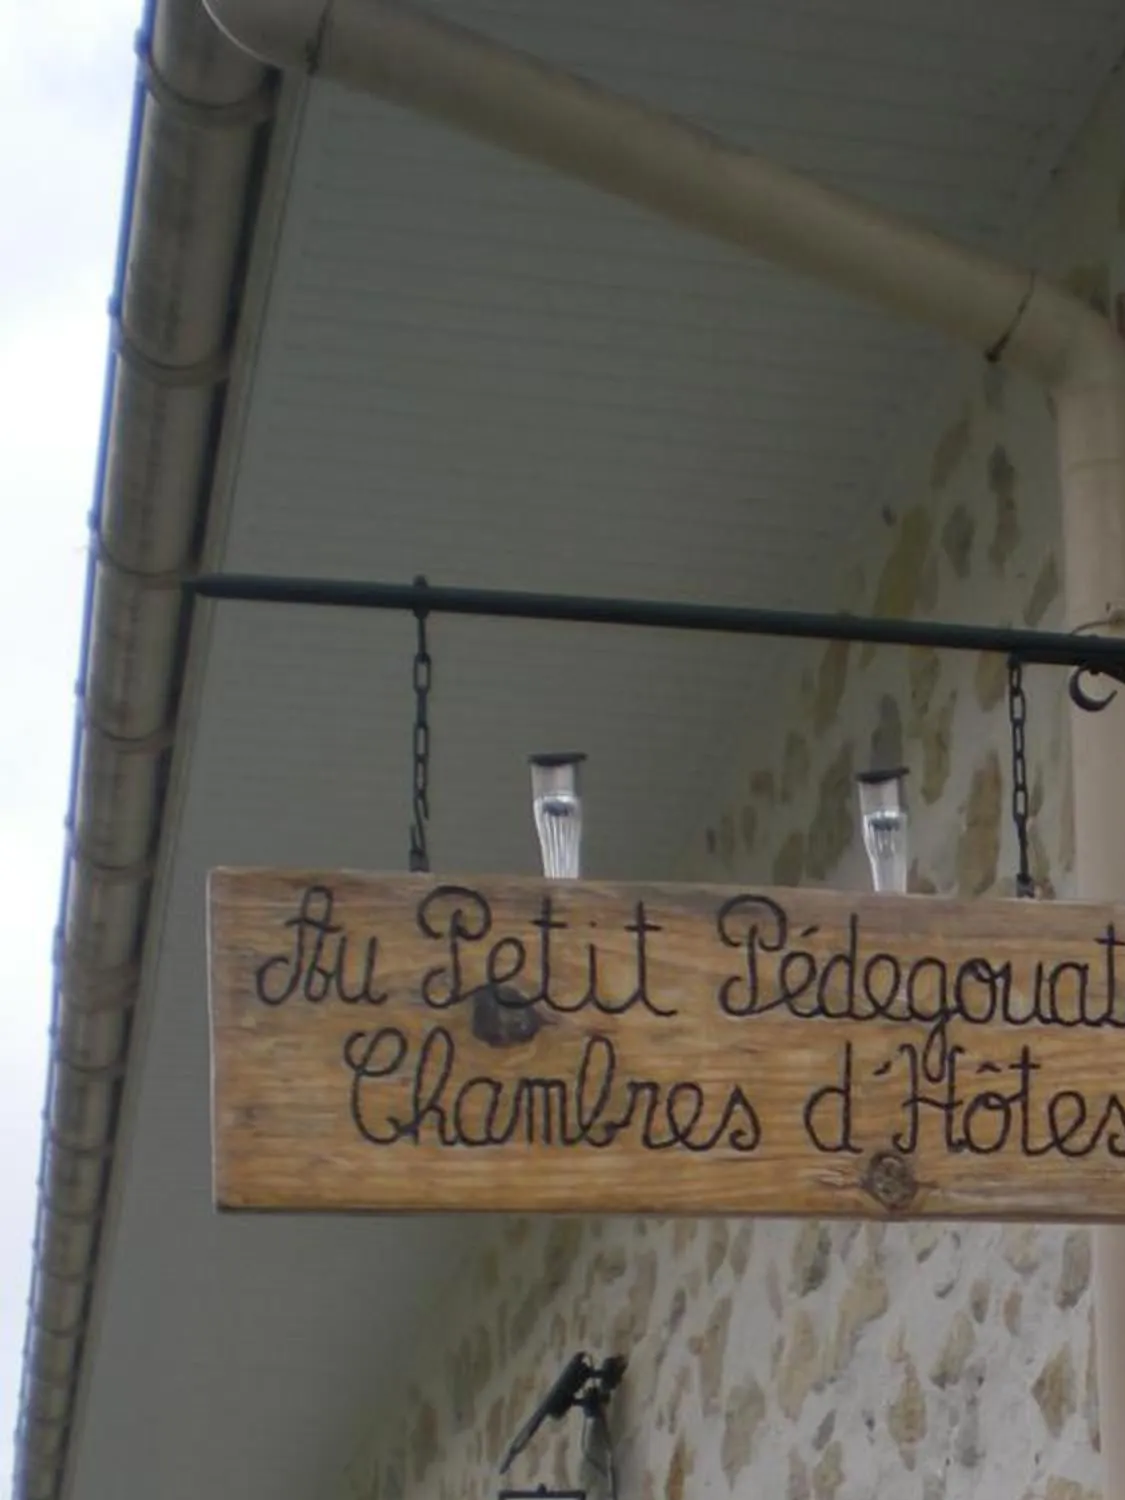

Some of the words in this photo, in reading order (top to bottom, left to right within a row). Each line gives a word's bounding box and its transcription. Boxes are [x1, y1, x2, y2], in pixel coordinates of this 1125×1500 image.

[255, 885, 389, 1006] Au
[416, 885, 678, 1018] Petit
[343, 1025, 762, 1153] Chambres
